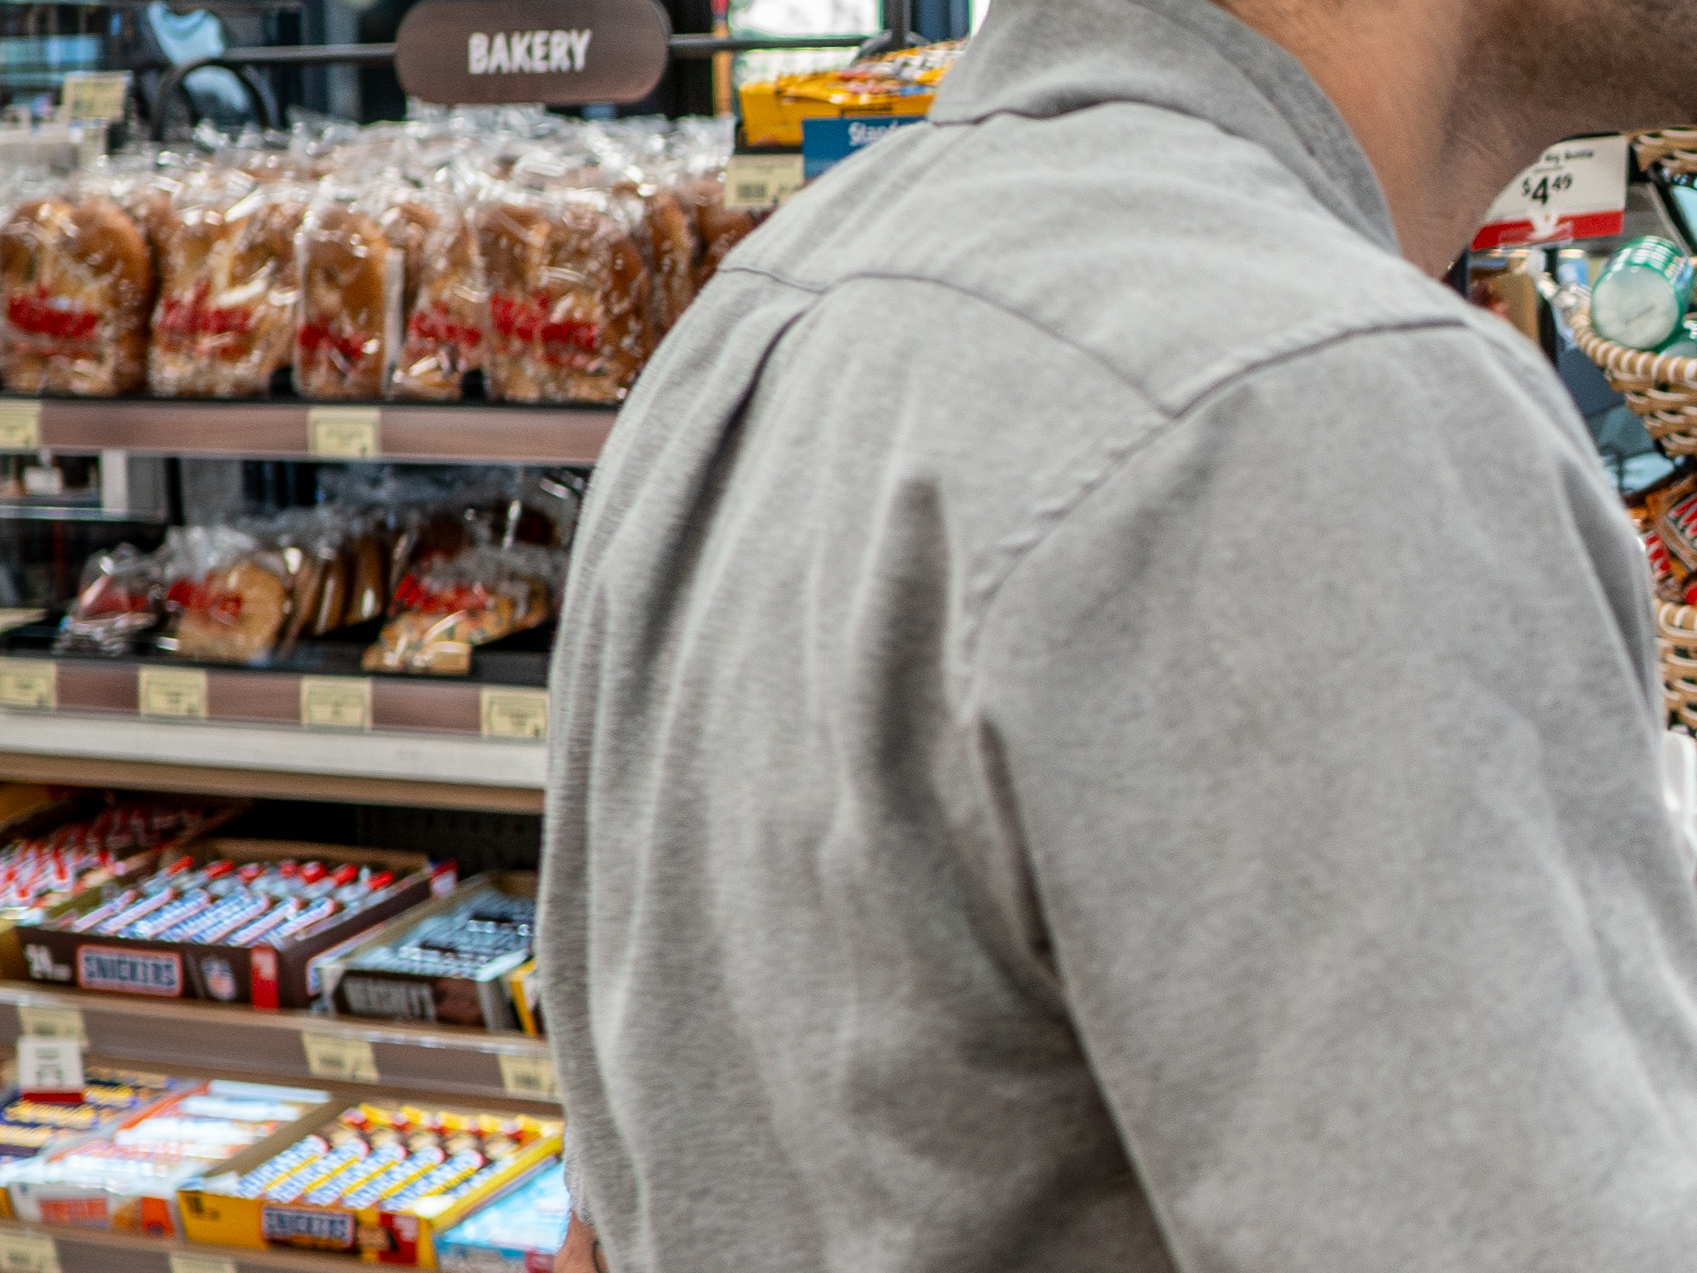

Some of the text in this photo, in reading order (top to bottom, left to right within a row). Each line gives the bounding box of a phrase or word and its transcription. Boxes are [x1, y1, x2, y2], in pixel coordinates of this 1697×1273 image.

[468, 29, 592, 75] BAKERY
[84, 953, 176, 989] SNICKERS
[264, 1209, 350, 1240] SNICKERS
